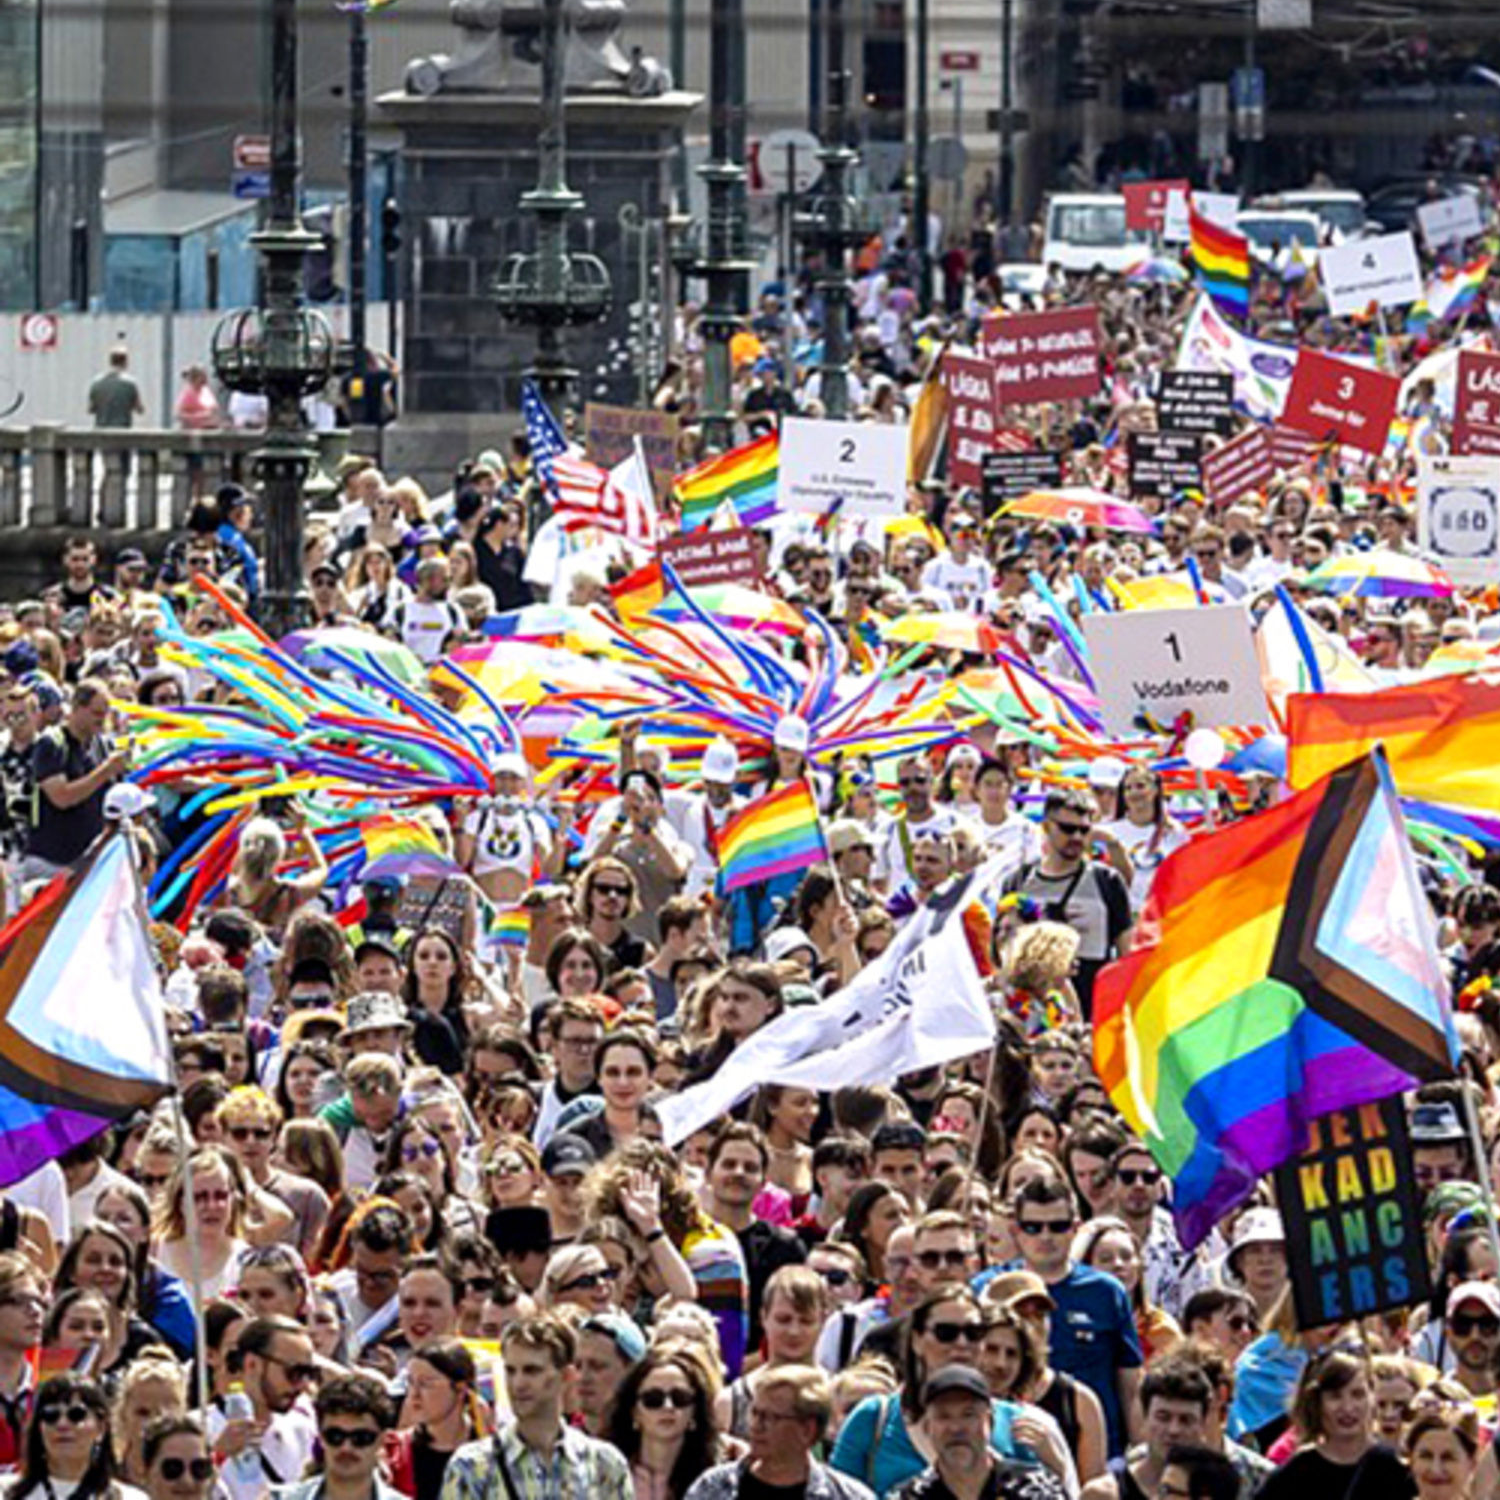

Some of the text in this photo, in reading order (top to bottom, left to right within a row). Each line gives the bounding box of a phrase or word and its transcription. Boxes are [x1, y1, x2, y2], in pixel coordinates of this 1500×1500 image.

[1361, 252, 1377, 270] 4
[1337, 376, 1355, 400] 3
[1465, 399, 1490, 422] JE
[838, 437, 857, 464] 2
[1164, 631, 1183, 663] 1
[1132, 677, 1230, 700] Vodafone
[1298, 1146, 1397, 1212] KAD
[1310, 1201, 1405, 1266] ANC
[1321, 1256, 1410, 1319] ERS
